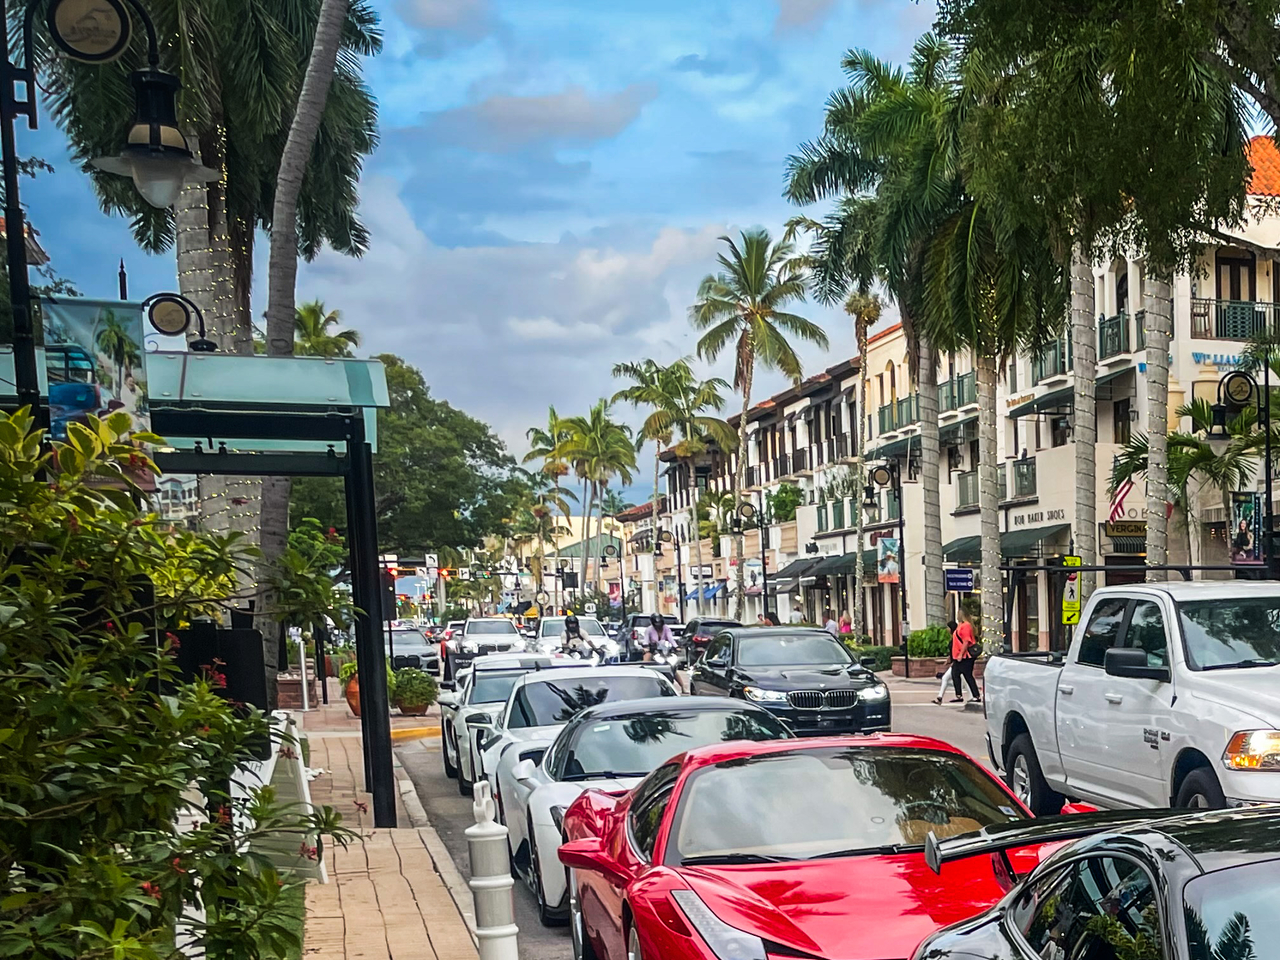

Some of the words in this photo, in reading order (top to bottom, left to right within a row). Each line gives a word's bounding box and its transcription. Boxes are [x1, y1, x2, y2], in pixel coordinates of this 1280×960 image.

[1014, 514, 1025, 526] BOB
[1027, 511, 1044, 524] BAKER
[1047, 508, 1065, 521] SHOES
